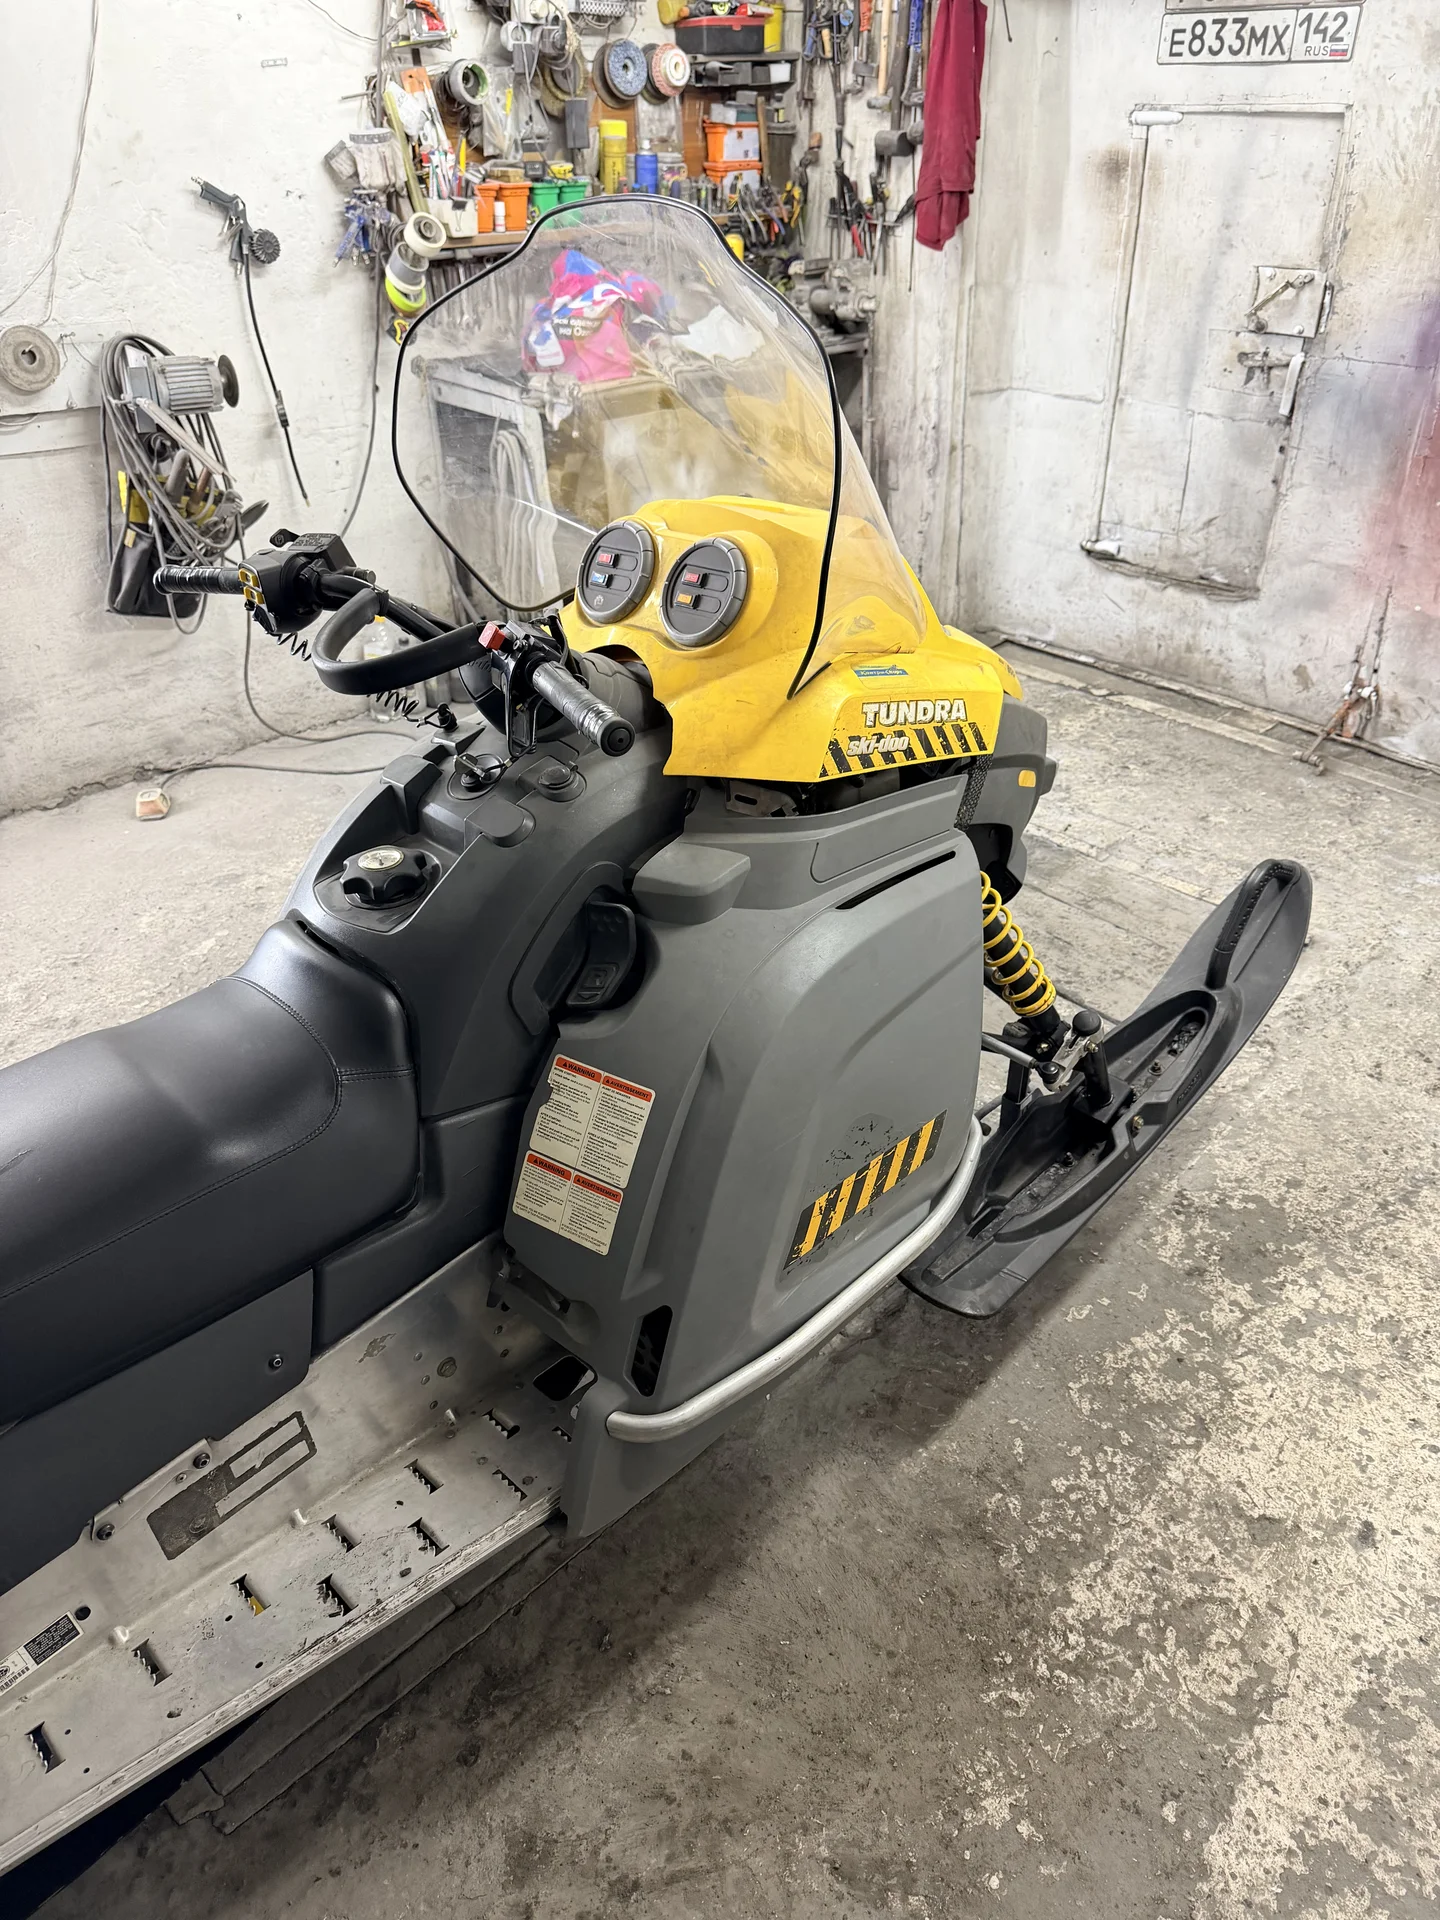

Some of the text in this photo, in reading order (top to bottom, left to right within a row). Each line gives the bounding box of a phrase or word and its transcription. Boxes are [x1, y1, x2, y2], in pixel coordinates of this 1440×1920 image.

[1299, 11, 1349, 44] 142
[1304, 45, 1329, 56] RUS
[862, 698, 968, 728] TUNDRA
[568, 1063, 596, 1079] WARNING
[610, 1080, 649, 1099] AVERTISSEMENT
[539, 1161, 565, 1176] WARNING
[581, 1180, 619, 1199] AVERTISSEMENT
